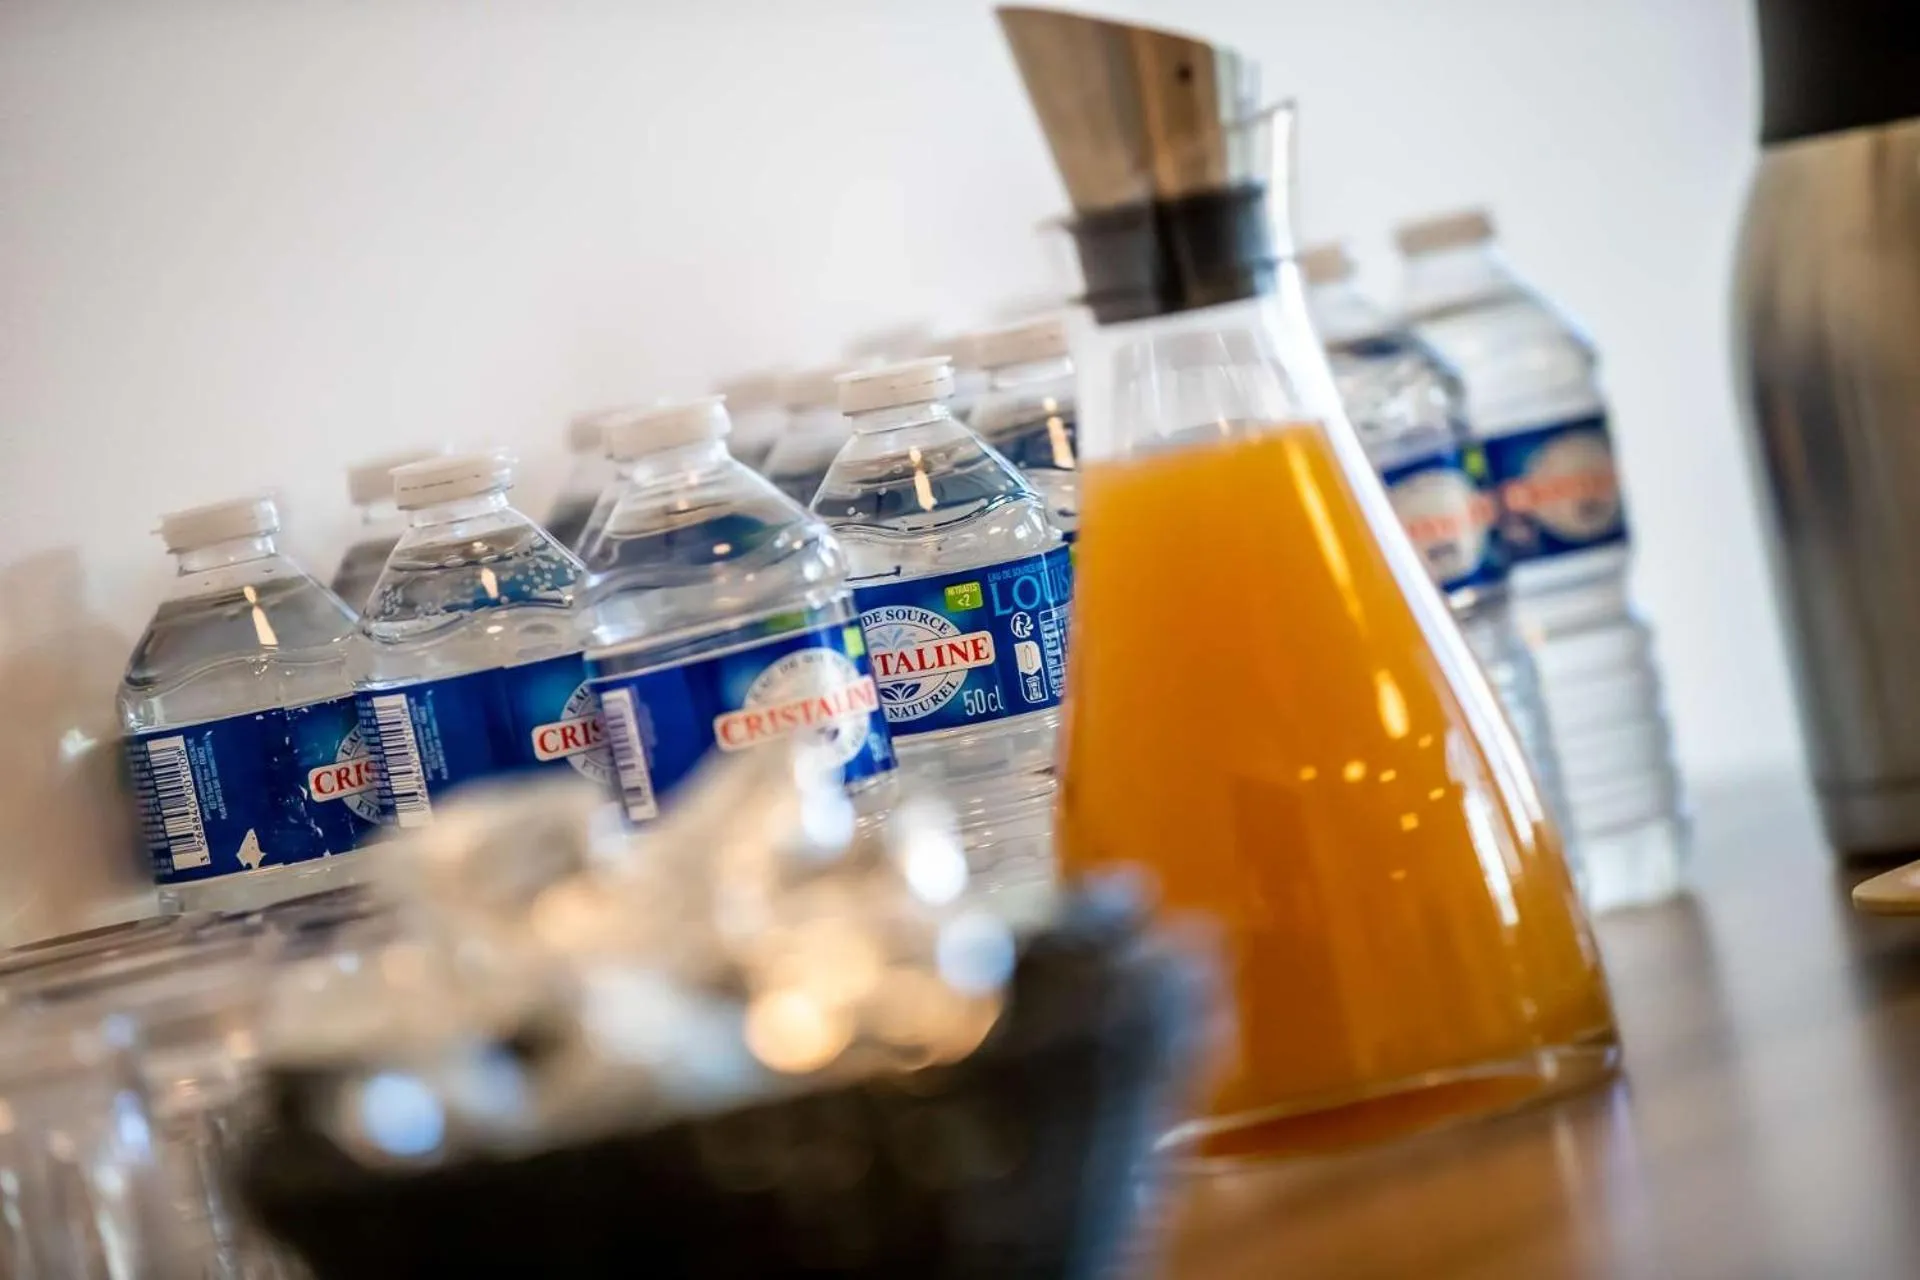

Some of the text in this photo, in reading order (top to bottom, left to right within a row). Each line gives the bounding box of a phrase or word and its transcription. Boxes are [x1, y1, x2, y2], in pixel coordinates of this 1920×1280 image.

[862, 607, 949, 634] DE SOURCE
[888, 678, 959, 720] NATUREL
[963, 685, 1004, 716] 50cl
